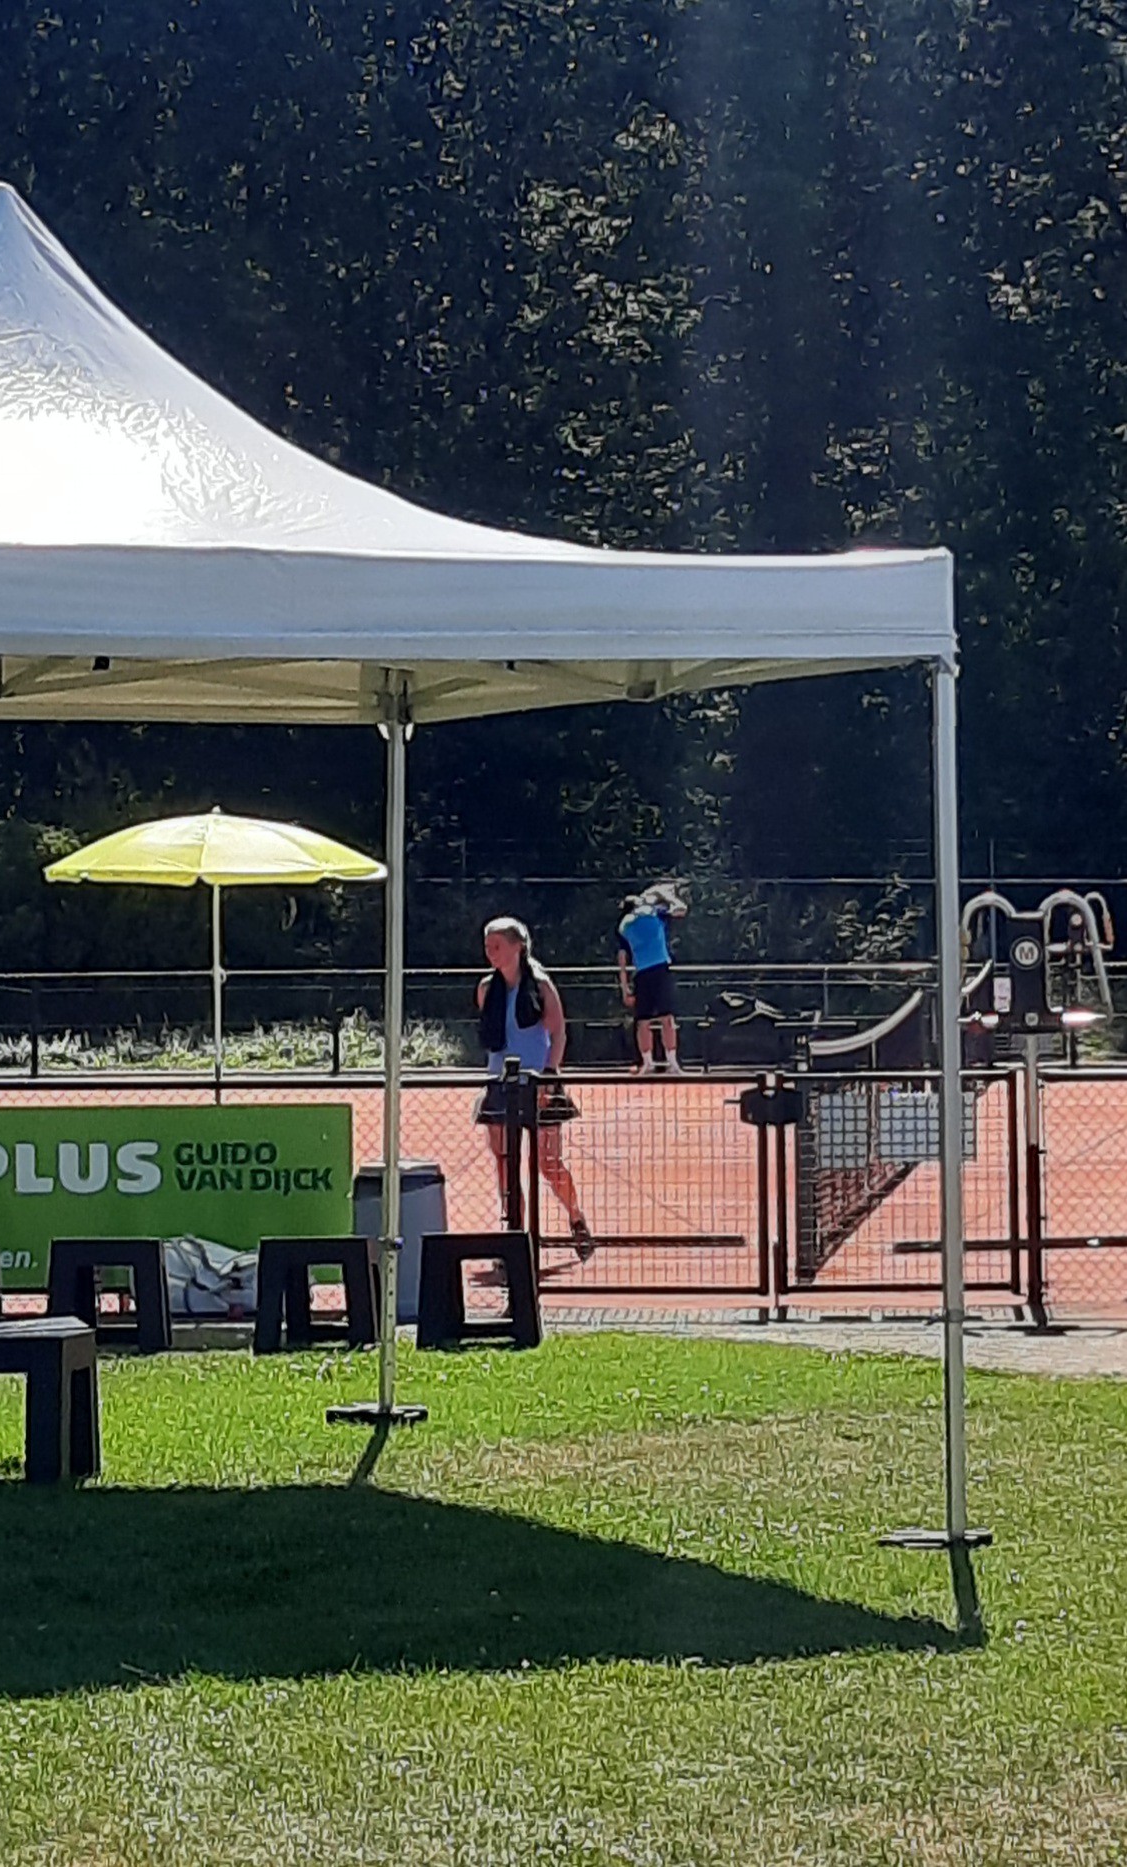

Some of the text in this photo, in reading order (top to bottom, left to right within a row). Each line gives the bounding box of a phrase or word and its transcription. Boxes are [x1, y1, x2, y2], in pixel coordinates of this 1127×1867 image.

[174, 1142, 278, 1166] GUIDO
[175, 1167, 333, 1197] VAN DIJCK
